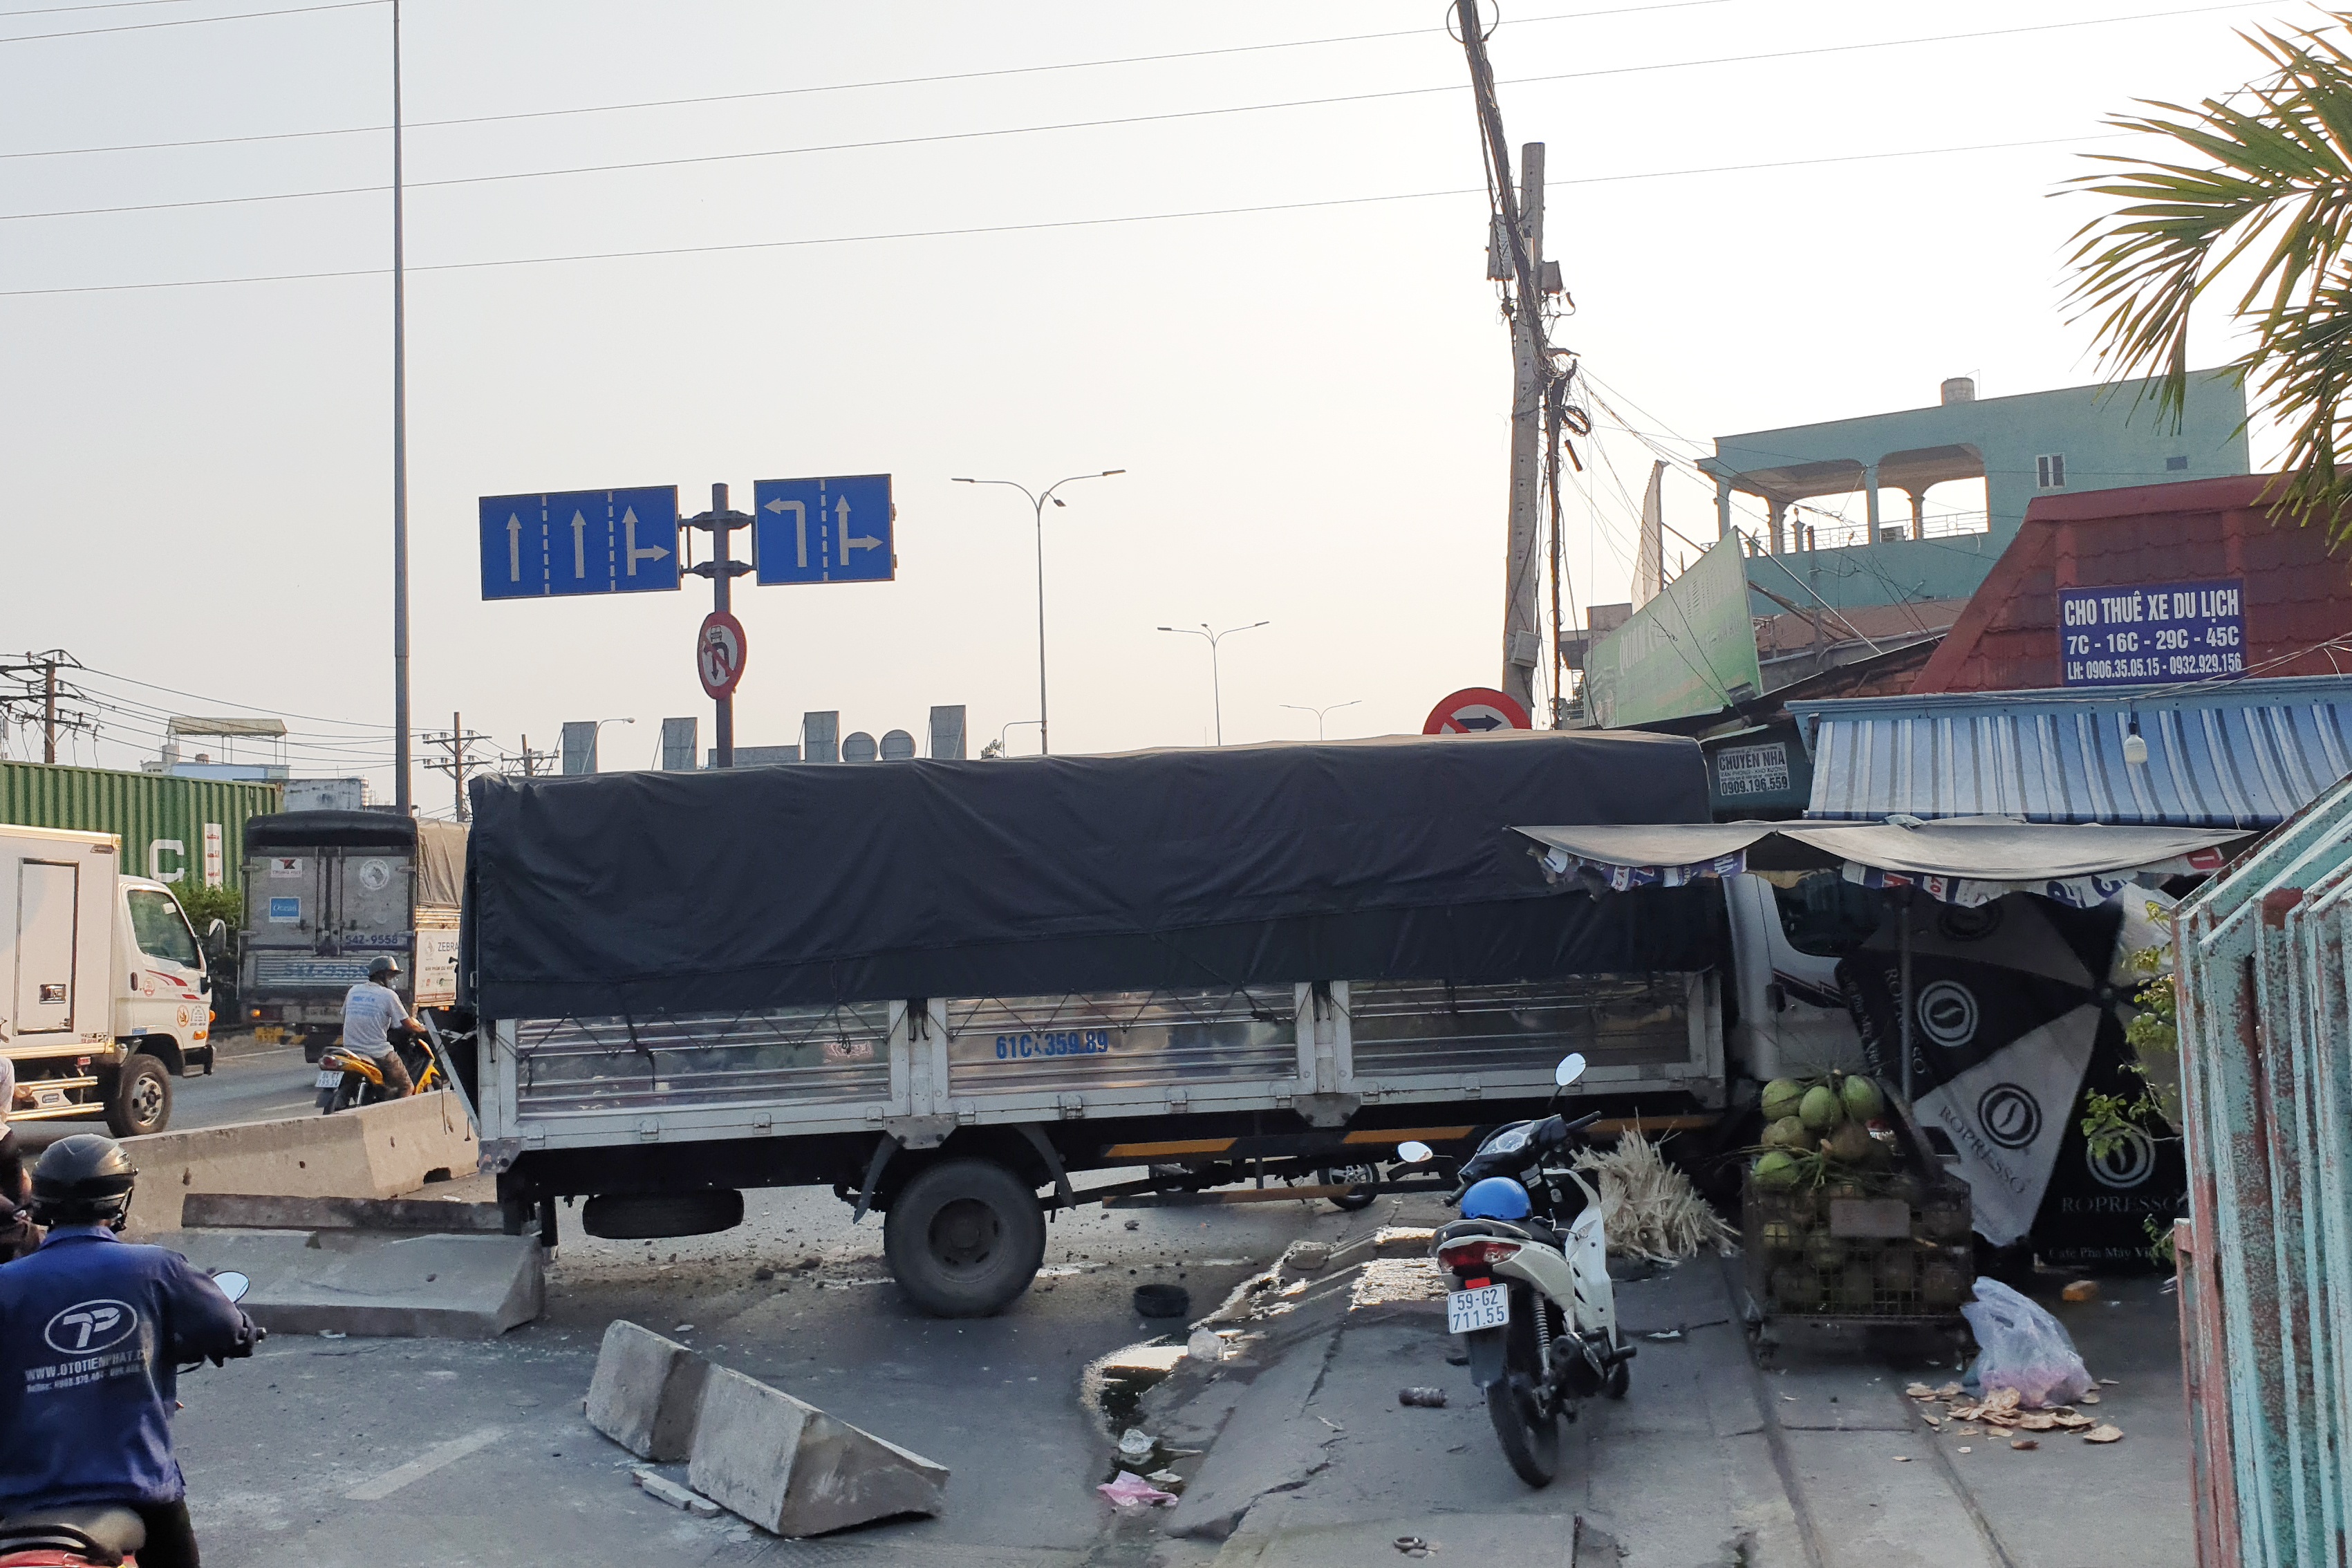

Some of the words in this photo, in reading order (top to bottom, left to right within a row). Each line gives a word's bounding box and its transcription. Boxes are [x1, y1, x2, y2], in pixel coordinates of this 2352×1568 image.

[2064, 599, 2097, 626] CHO
[2100, 590, 2143, 624] THUÊ
[2147, 594, 2169, 621] XE
[2174, 590, 2196, 619] DU
[2201, 588, 2239, 623] LỊCH
[2066, 635, 2090, 655] 7C
[2107, 631, 2138, 653] 16C
[2155, 628, 2189, 651] 29C
[2205, 625, 2240, 647] 45C
[2067, 661, 2084, 680] LH:
[2086, 657, 2160, 680] 0906.35.05.15
[2169, 652, 2243, 675] 0932.929.156
[1762, 747, 1786, 767] NHÀ
[1721, 776, 1788, 795] 0909.196.559
[438, 941, 459, 952] ZEBRA
[1939, 1105, 2026, 1194] ROPRESSO
[2062, 1196, 2183, 1213] ROPRESSO
[1457, 1287, 1499, 1312] 59-G2
[1453, 1305, 1505, 1332] 711.55
[24, 1350, 144, 1381] WWW.OTOTIENPHAT.C
